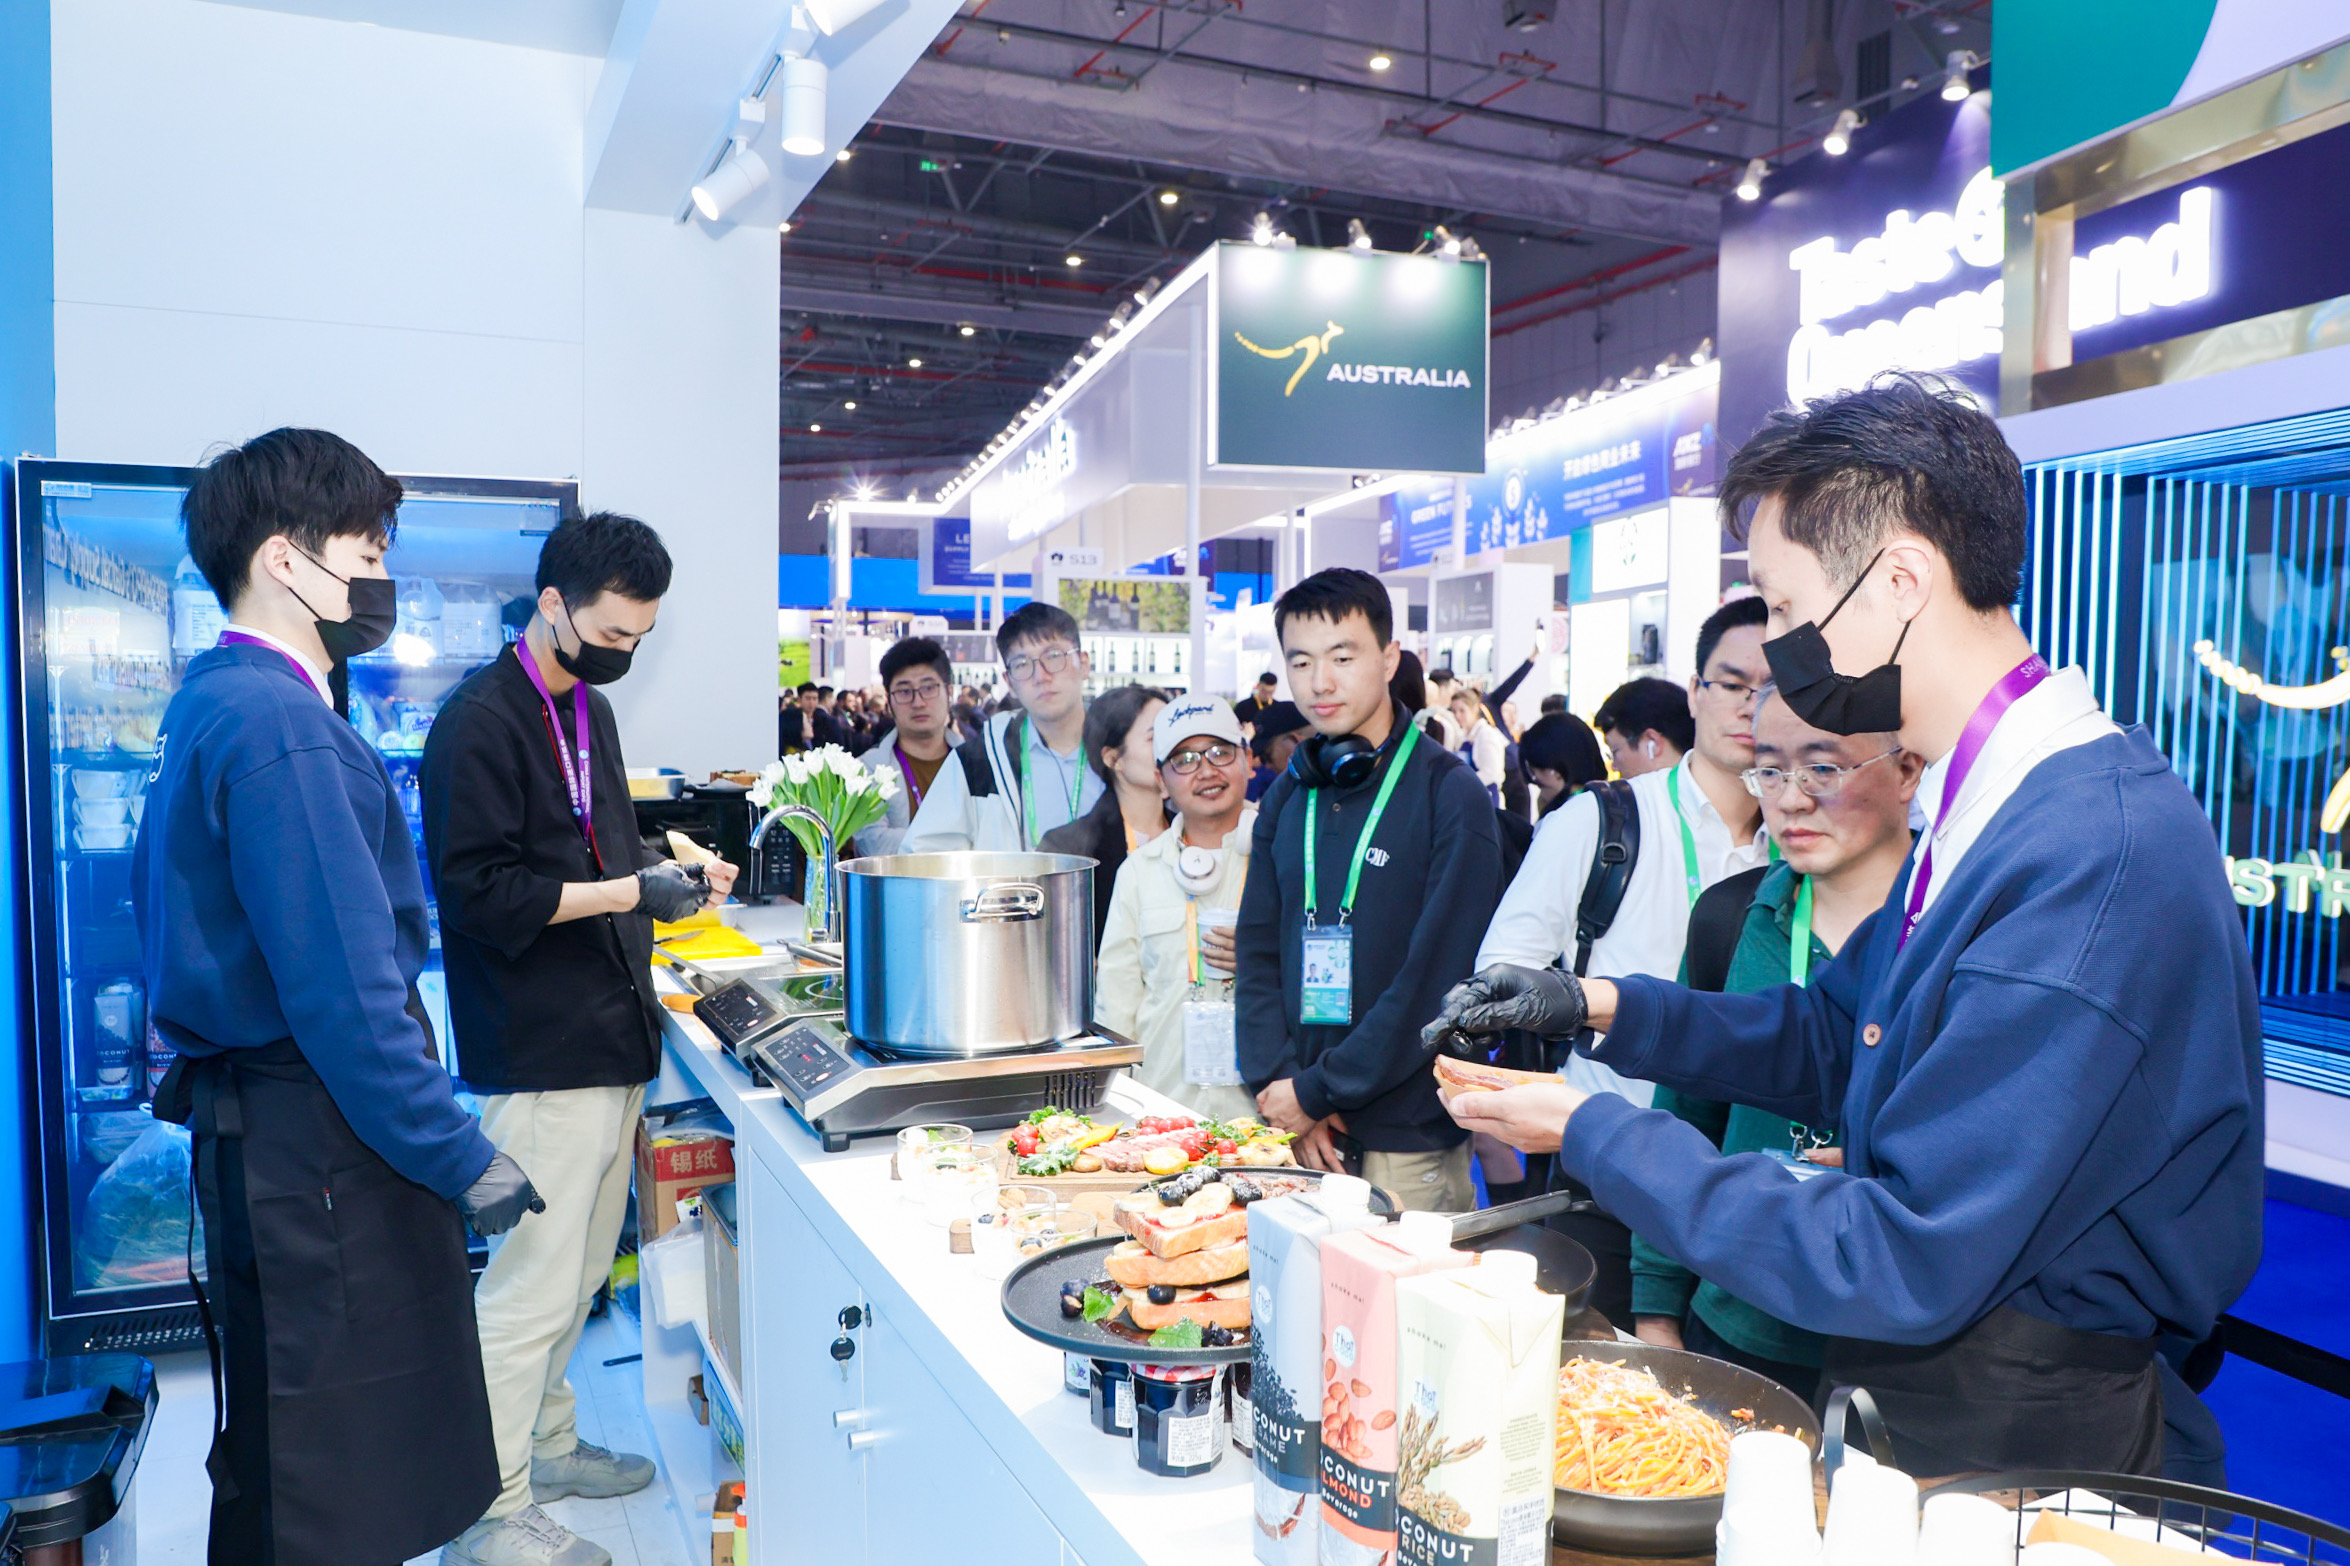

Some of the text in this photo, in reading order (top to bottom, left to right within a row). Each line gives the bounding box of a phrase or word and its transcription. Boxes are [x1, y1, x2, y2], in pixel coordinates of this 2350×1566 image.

[1326, 362, 1472, 389] AUSTRALIA
[2224, 856, 2350, 918] STR
[671, 1148, 717, 1173] 锡纸
[1401, 1535, 1436, 1566] RICE
